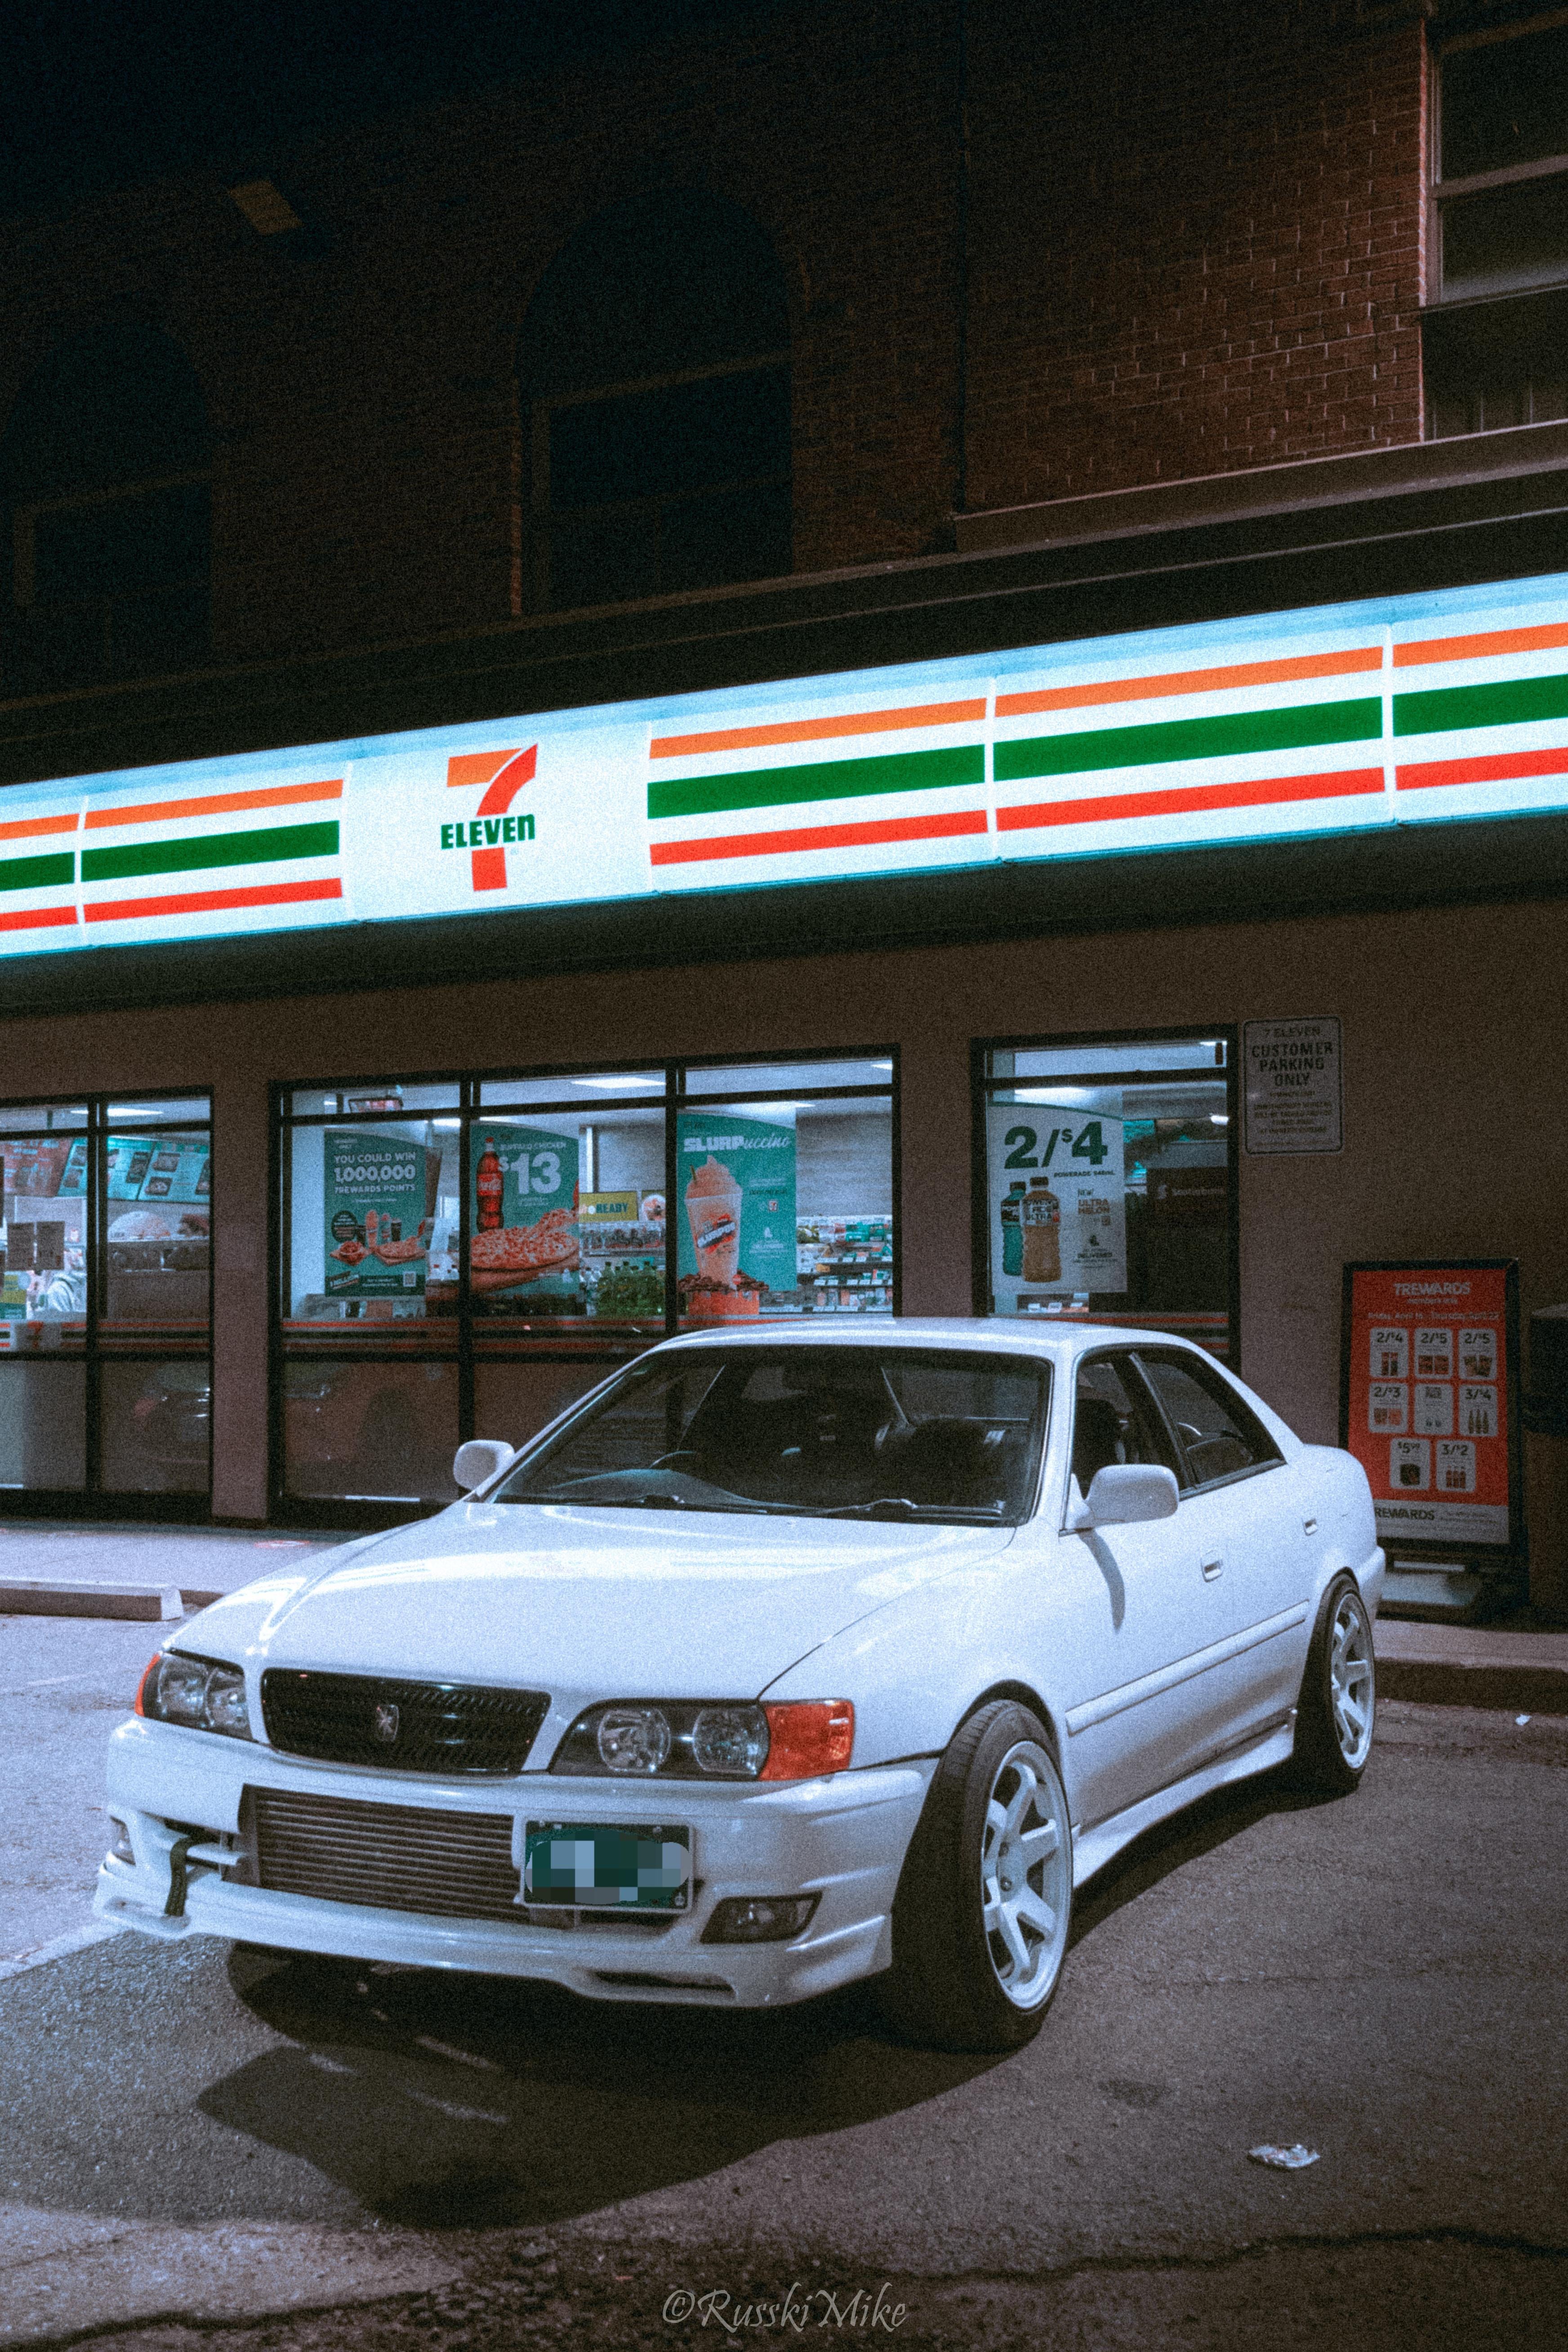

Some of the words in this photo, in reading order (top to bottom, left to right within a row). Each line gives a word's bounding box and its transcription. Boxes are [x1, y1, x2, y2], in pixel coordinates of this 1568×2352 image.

[447, 743, 538, 891] 7
[1252, 1042, 1333, 1057] CUSTOMER
[1259, 1058, 1325, 1072] PARKING
[1274, 1073, 1310, 1087] ONLY
[334, 1155, 355, 1163] YOU
[357, 1154, 392, 1163] COULD
[394, 1152, 416, 1161] WIN
[334, 1164, 416, 1184] 1,000,000
[498, 1151, 561, 1194] $13
[383, 1183, 415, 1192] POINTS
[1078, 1198, 1109, 1207] ULTRA
